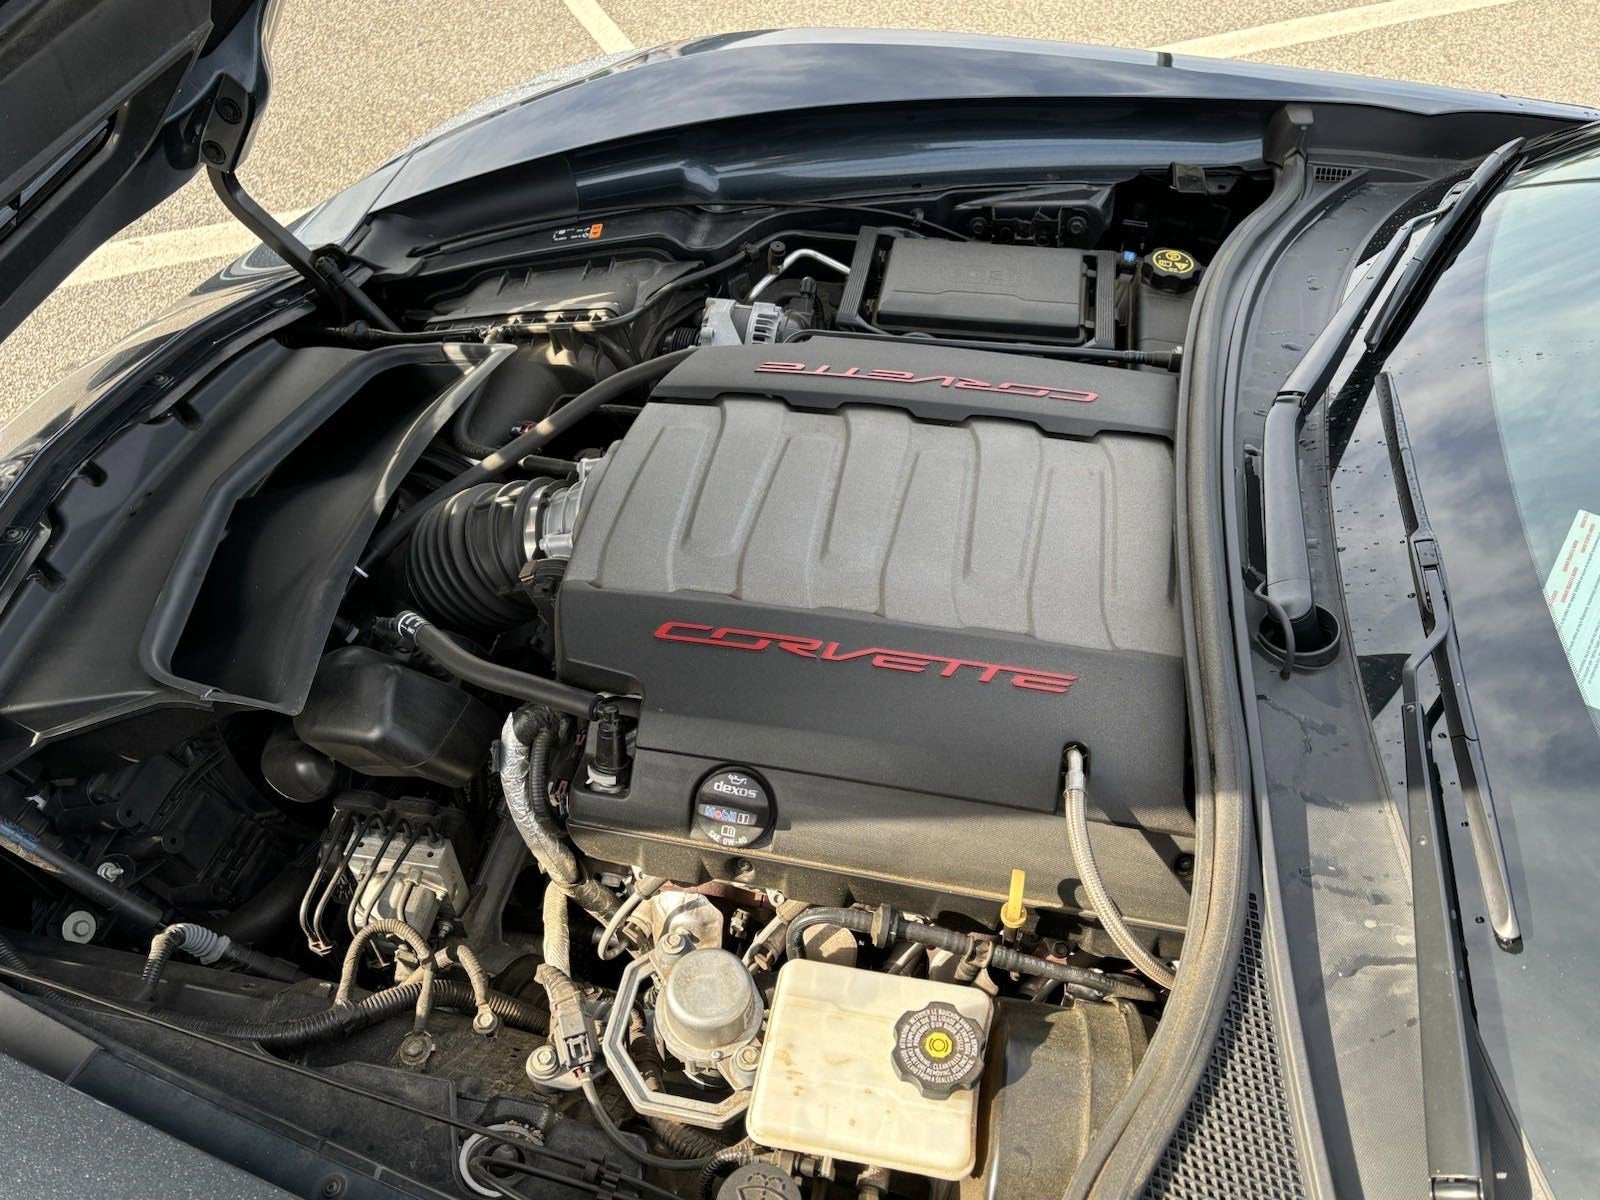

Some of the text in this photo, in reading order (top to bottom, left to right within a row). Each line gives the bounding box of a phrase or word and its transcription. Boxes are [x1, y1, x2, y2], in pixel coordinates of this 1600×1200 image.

[754, 361, 1099, 404] CORVETTE
[653, 621, 1081, 694] CORVETTE
[713, 780, 759, 799] dexos
[704, 805, 737, 823] Mobil
[708, 829, 748, 847] SAE 0W-40
